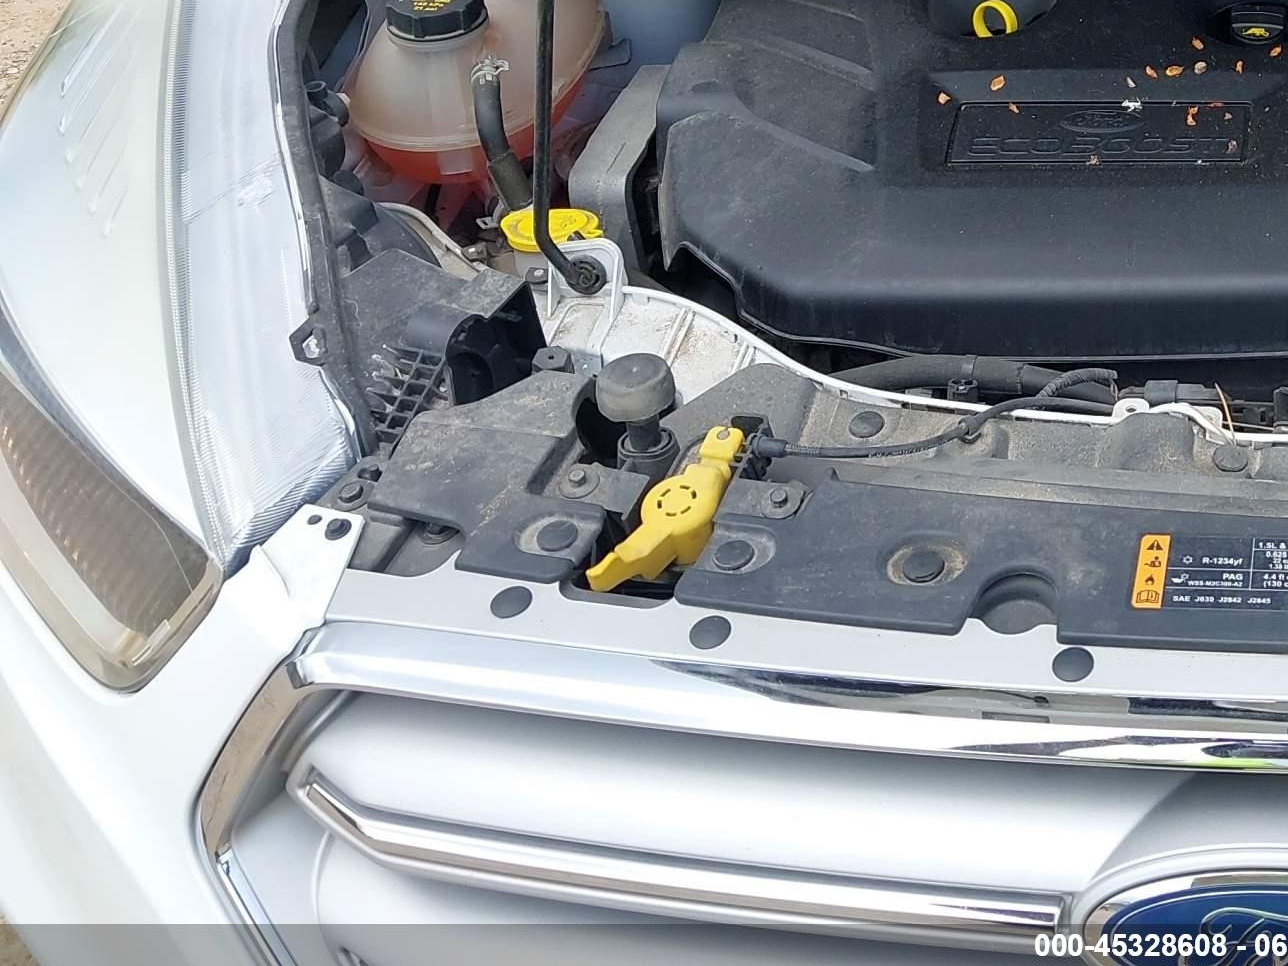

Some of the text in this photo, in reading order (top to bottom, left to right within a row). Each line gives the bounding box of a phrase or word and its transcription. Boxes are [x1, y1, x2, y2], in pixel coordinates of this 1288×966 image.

[1202, 557, 1244, 567] R-1234yf
[1222, 573, 1243, 581] PAG
[1263, 573, 1277, 581] 4.4
[1263, 580, 1283, 588] (130
